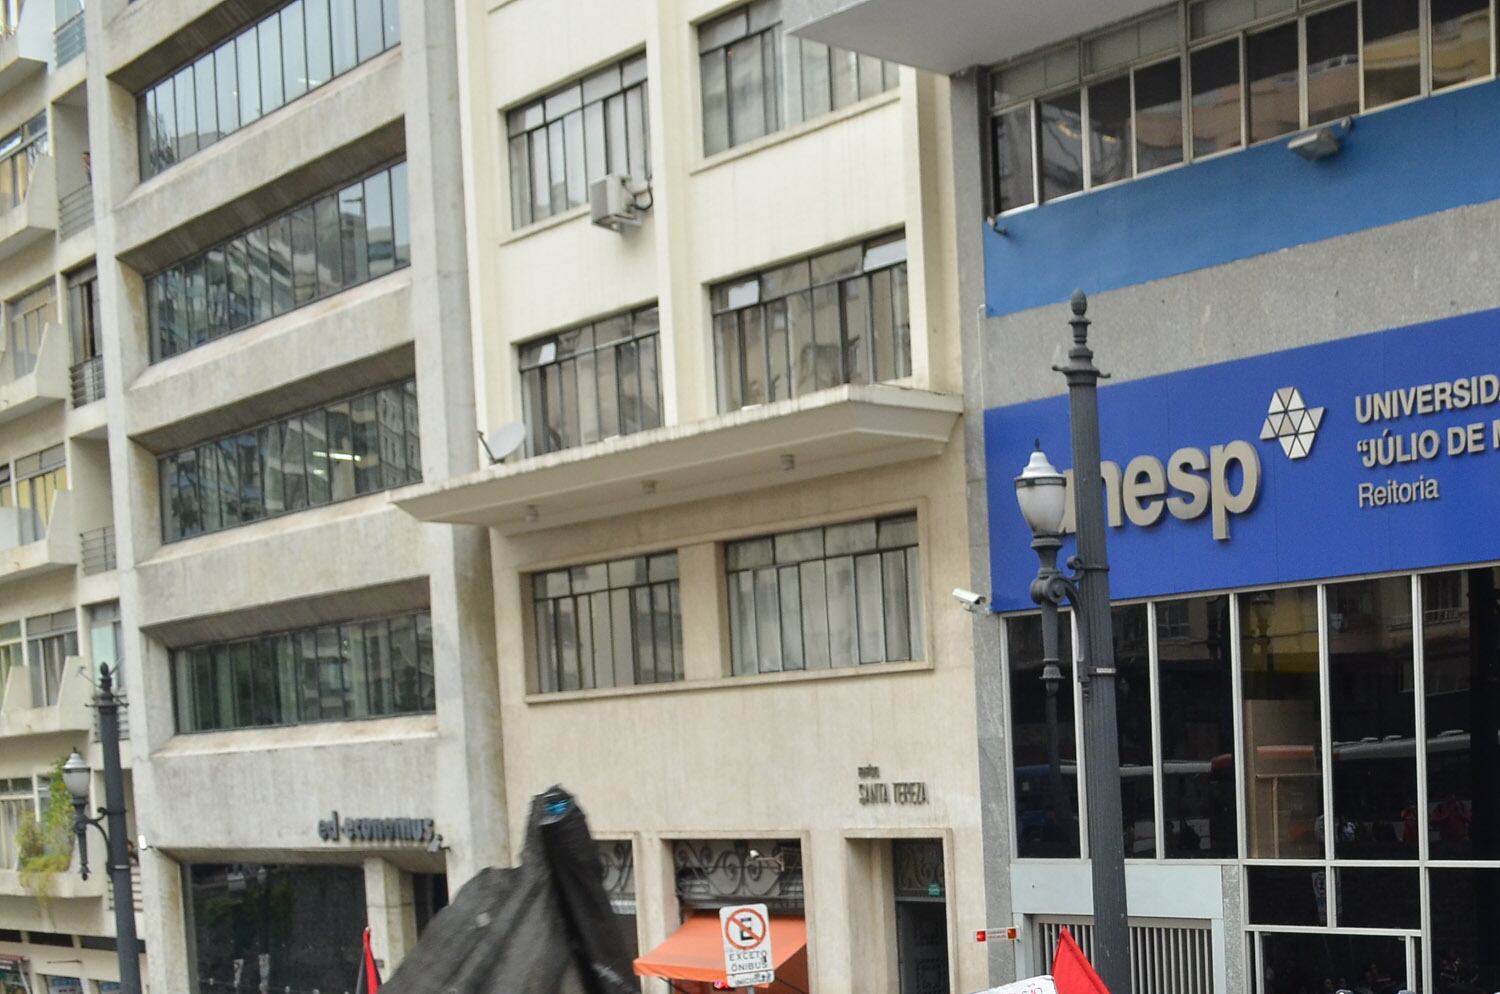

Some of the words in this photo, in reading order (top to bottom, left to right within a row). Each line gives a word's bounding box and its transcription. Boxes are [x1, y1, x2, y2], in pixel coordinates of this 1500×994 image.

[1447, 422, 1486, 457] DE
[1358, 475, 1440, 509] Reitoria
[858, 783, 890, 806] SANTA
[892, 782, 929, 806] TEREZA
[729, 950, 767, 961] EXCETO
